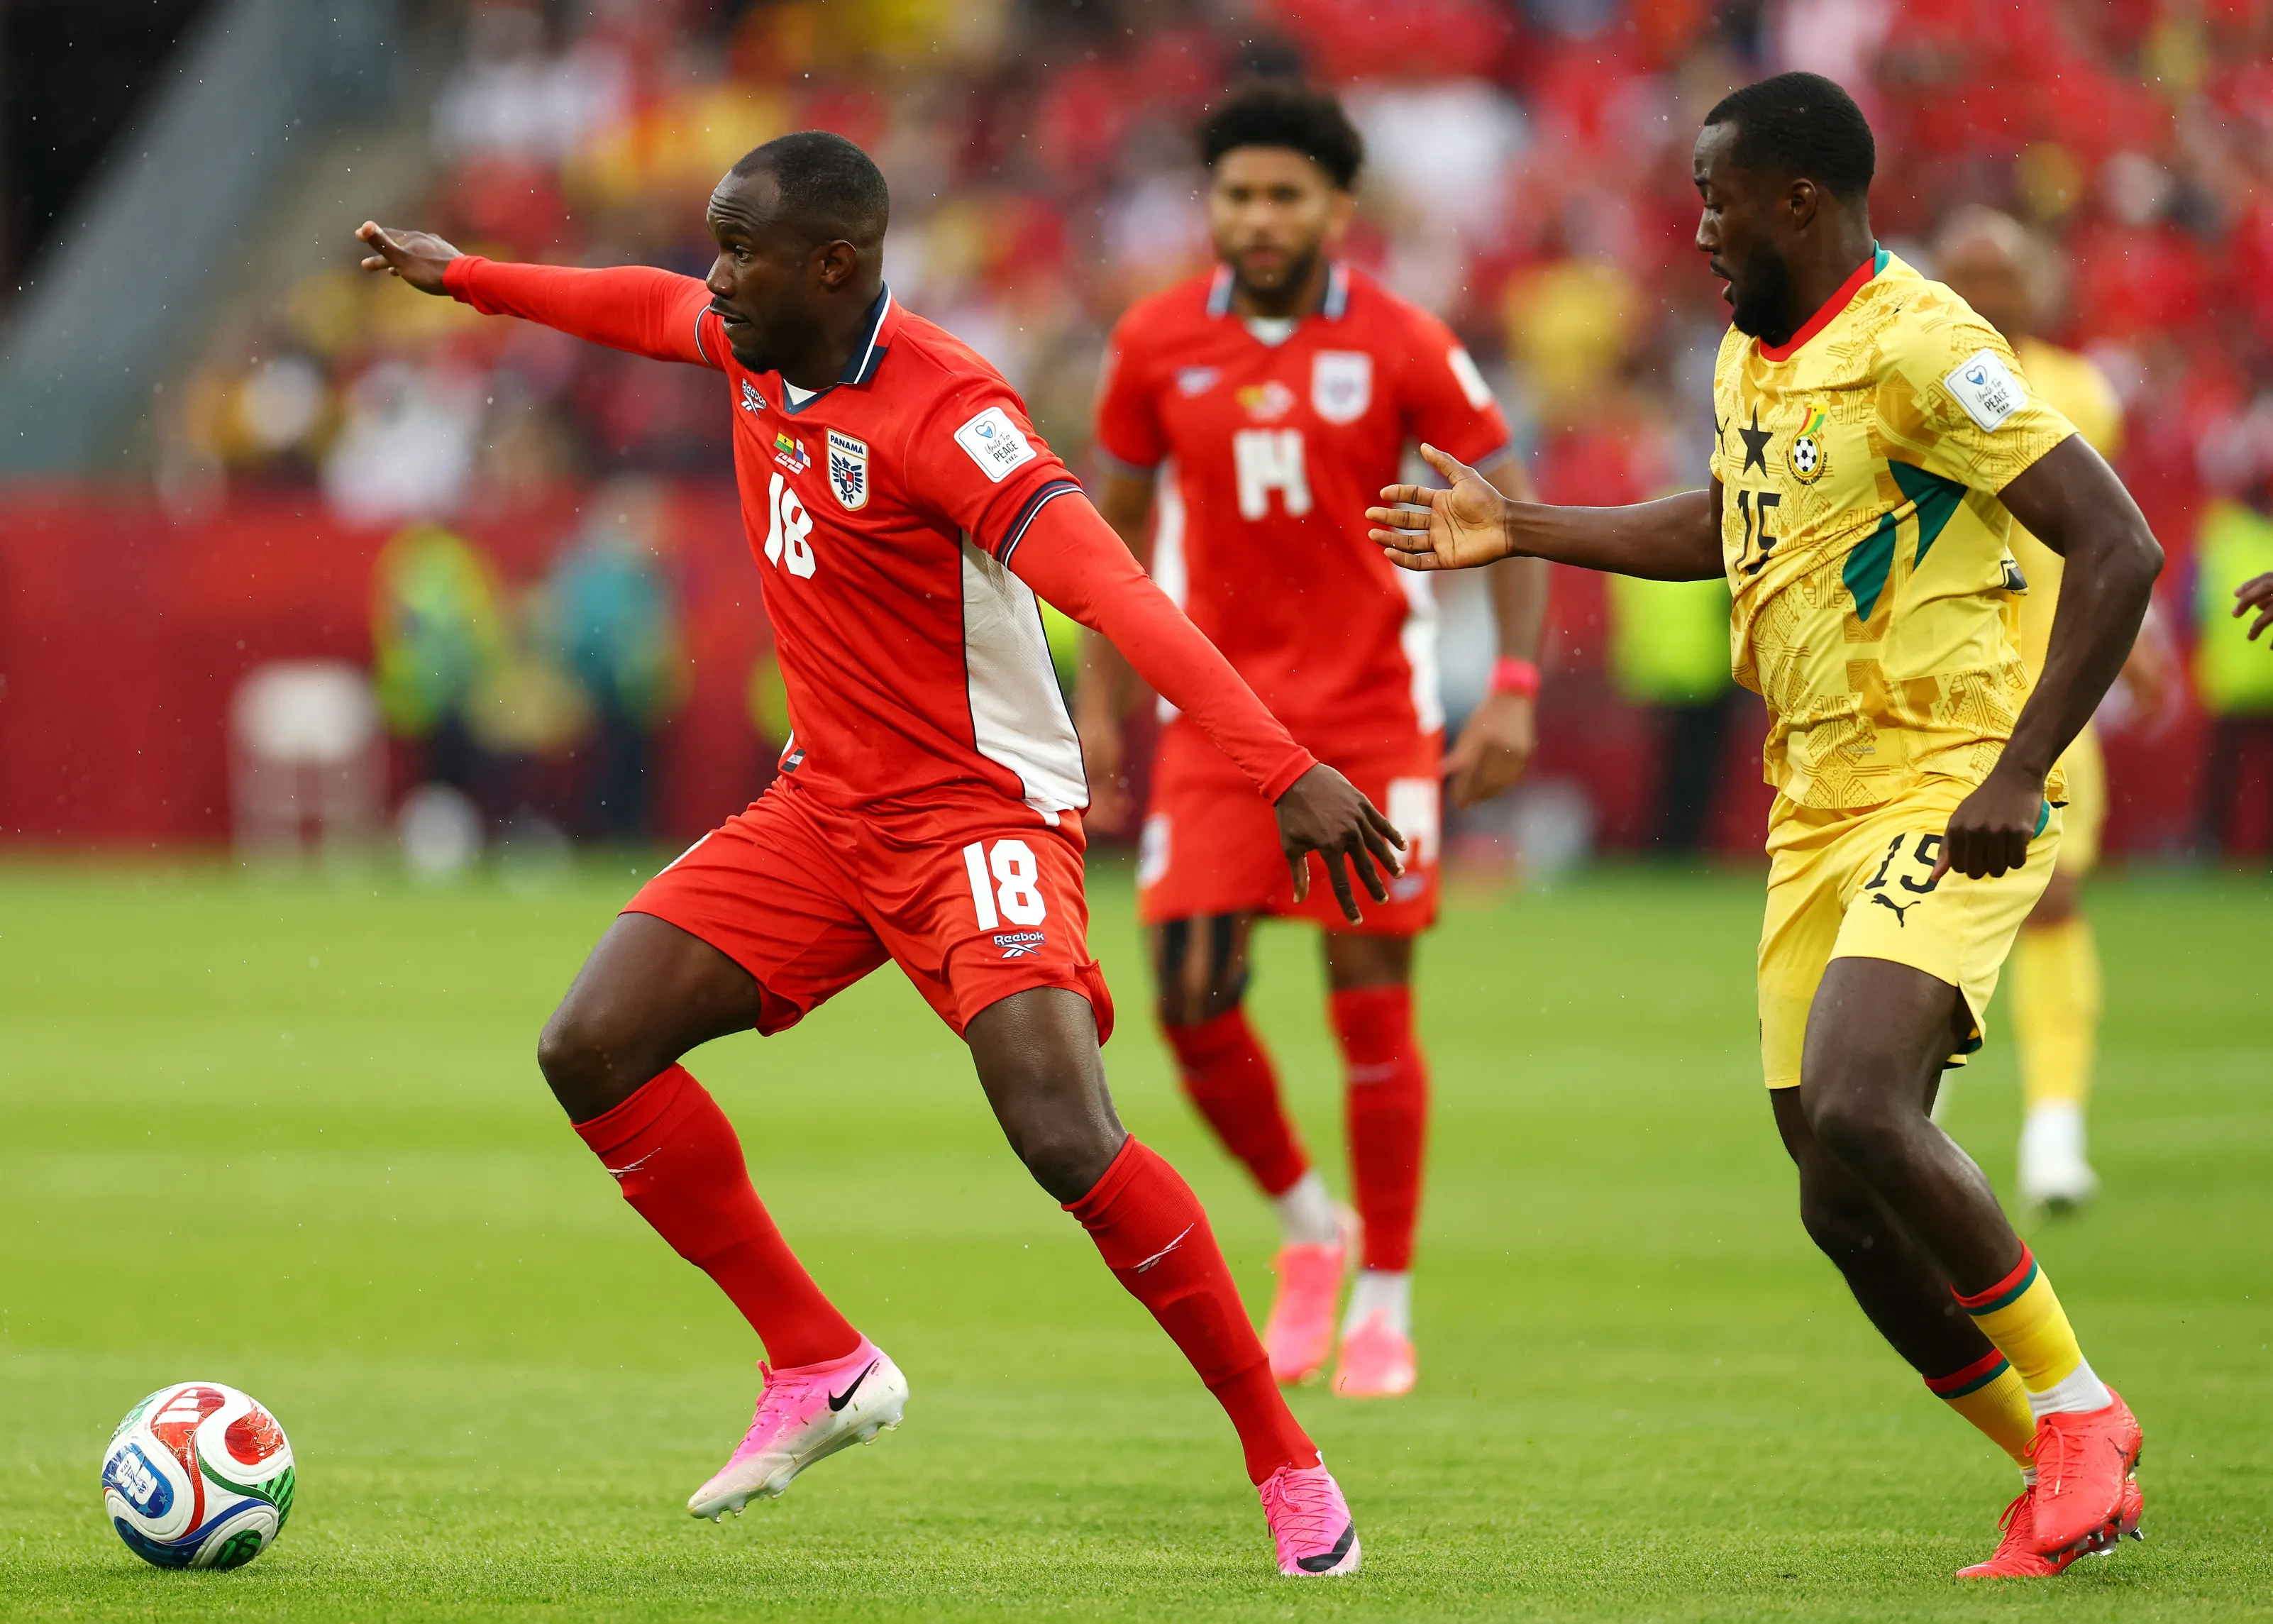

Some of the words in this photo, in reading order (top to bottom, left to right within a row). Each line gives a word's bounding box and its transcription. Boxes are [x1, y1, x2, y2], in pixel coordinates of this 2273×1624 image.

[1984, 387, 2010, 411] PEACE
[1996, 402, 2011, 414] FIFA
[830, 434, 863, 455] PANAMÁ
[985, 438, 1002, 455] Unite
[1000, 431, 1011, 443] For
[992, 441, 1019, 463] PEACE
[1005, 453, 1019, 465] FIFA
[764, 471, 817, 580] 18
[1735, 490, 1781, 576] 15
[963, 839, 1047, 932] 18
[993, 932, 1044, 945] Reebok
